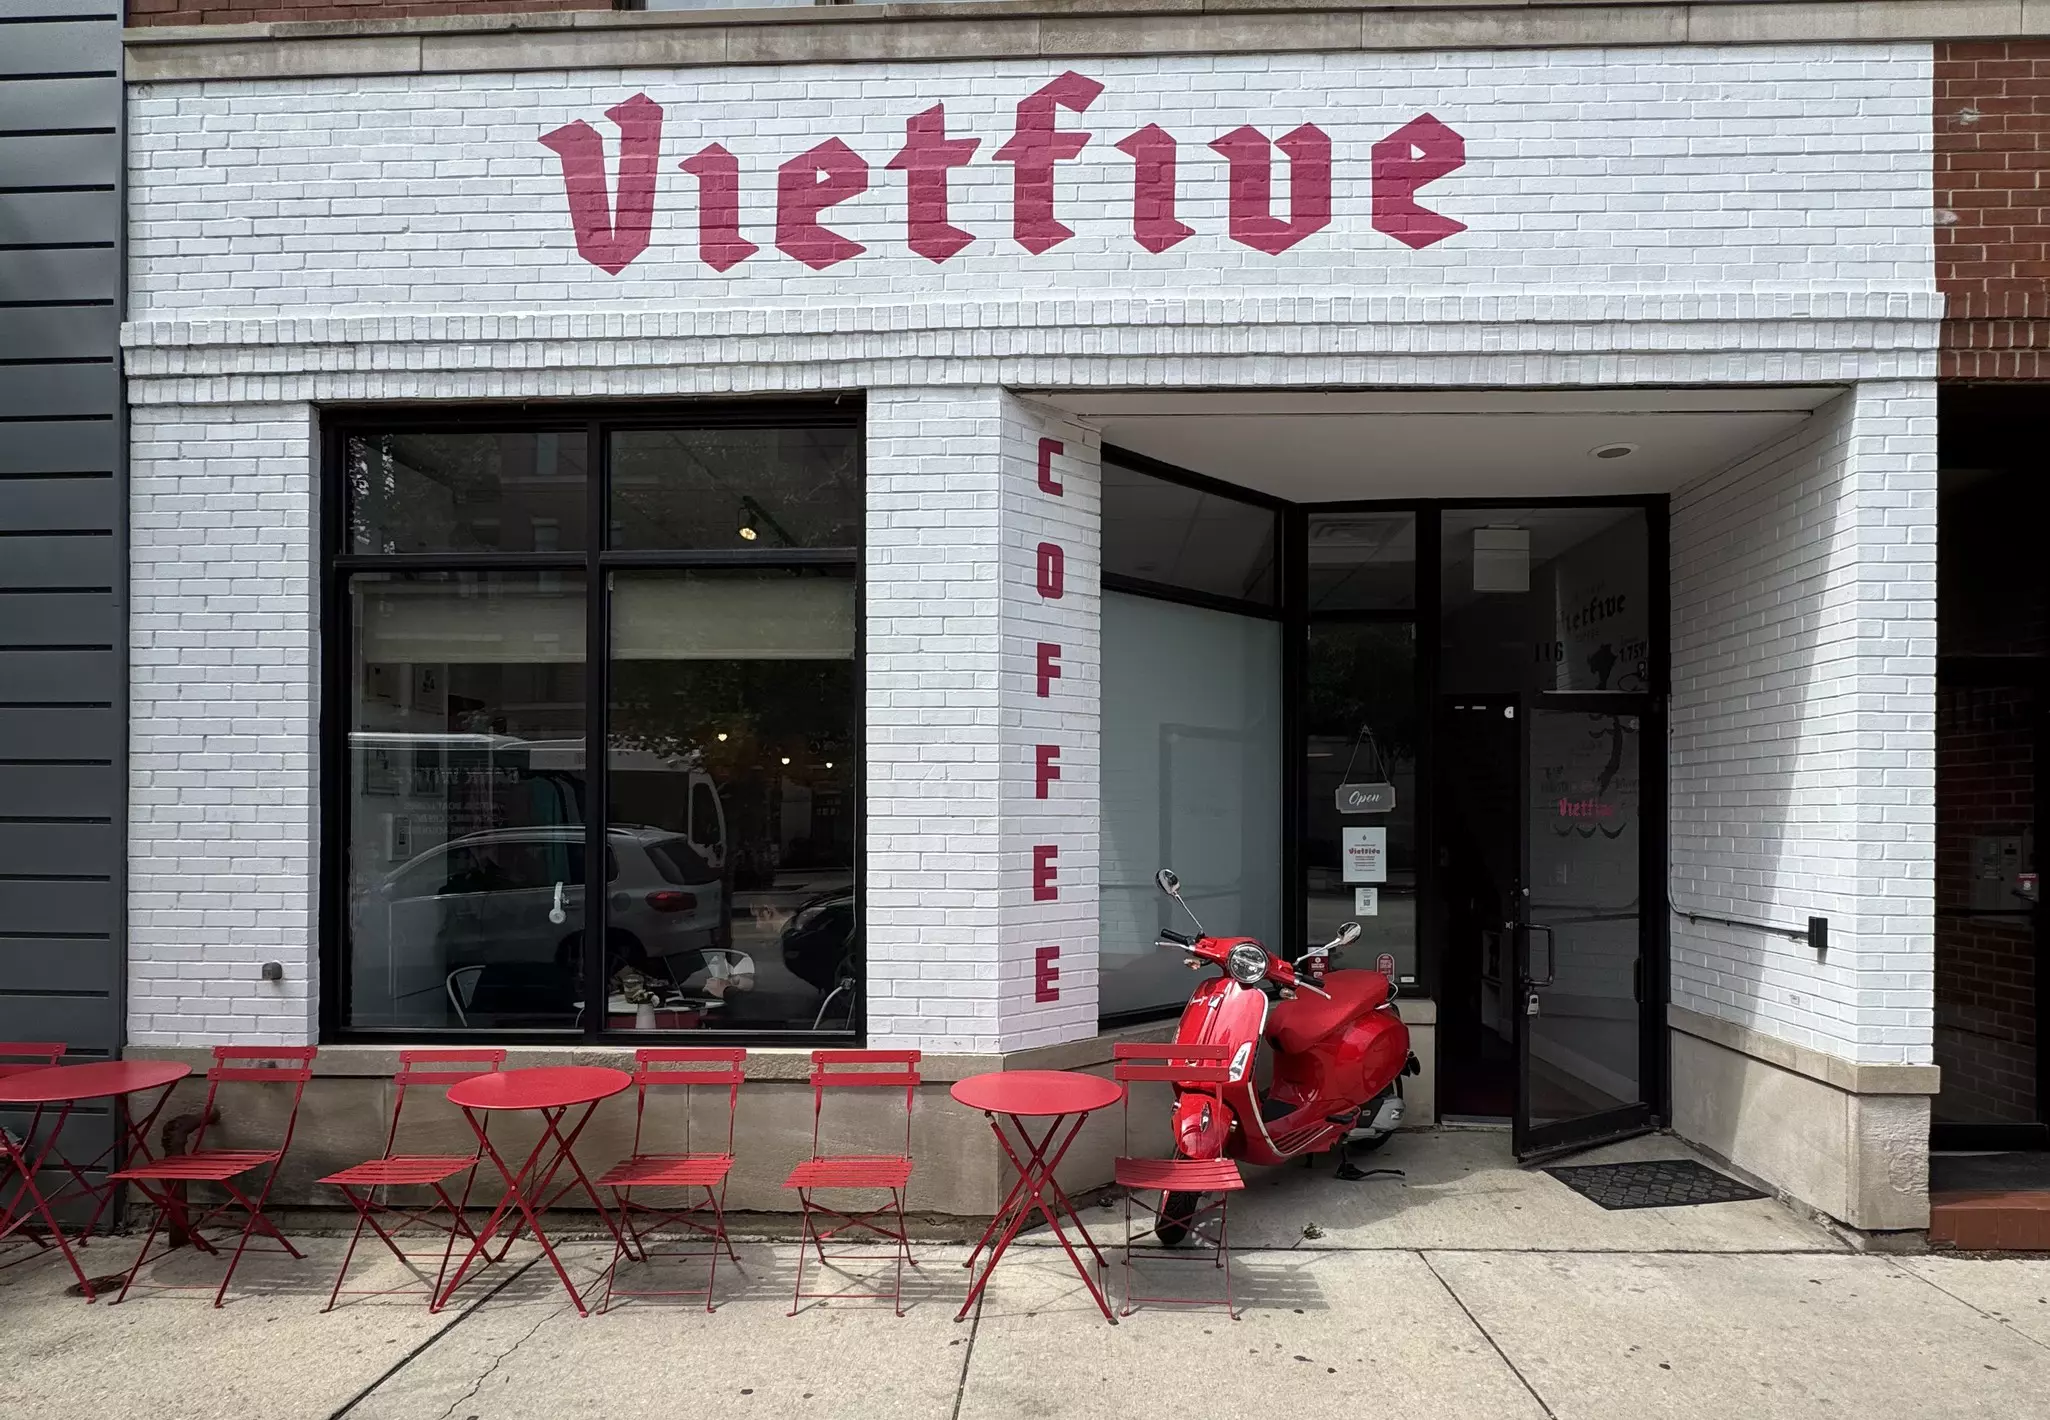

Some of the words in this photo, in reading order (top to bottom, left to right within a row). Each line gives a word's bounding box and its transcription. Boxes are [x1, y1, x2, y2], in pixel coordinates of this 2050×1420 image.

[539, 70, 1468, 275] Vietfive
[1033, 437, 1064, 1002] COFFEE
[1348, 790, 1382, 807] Open
